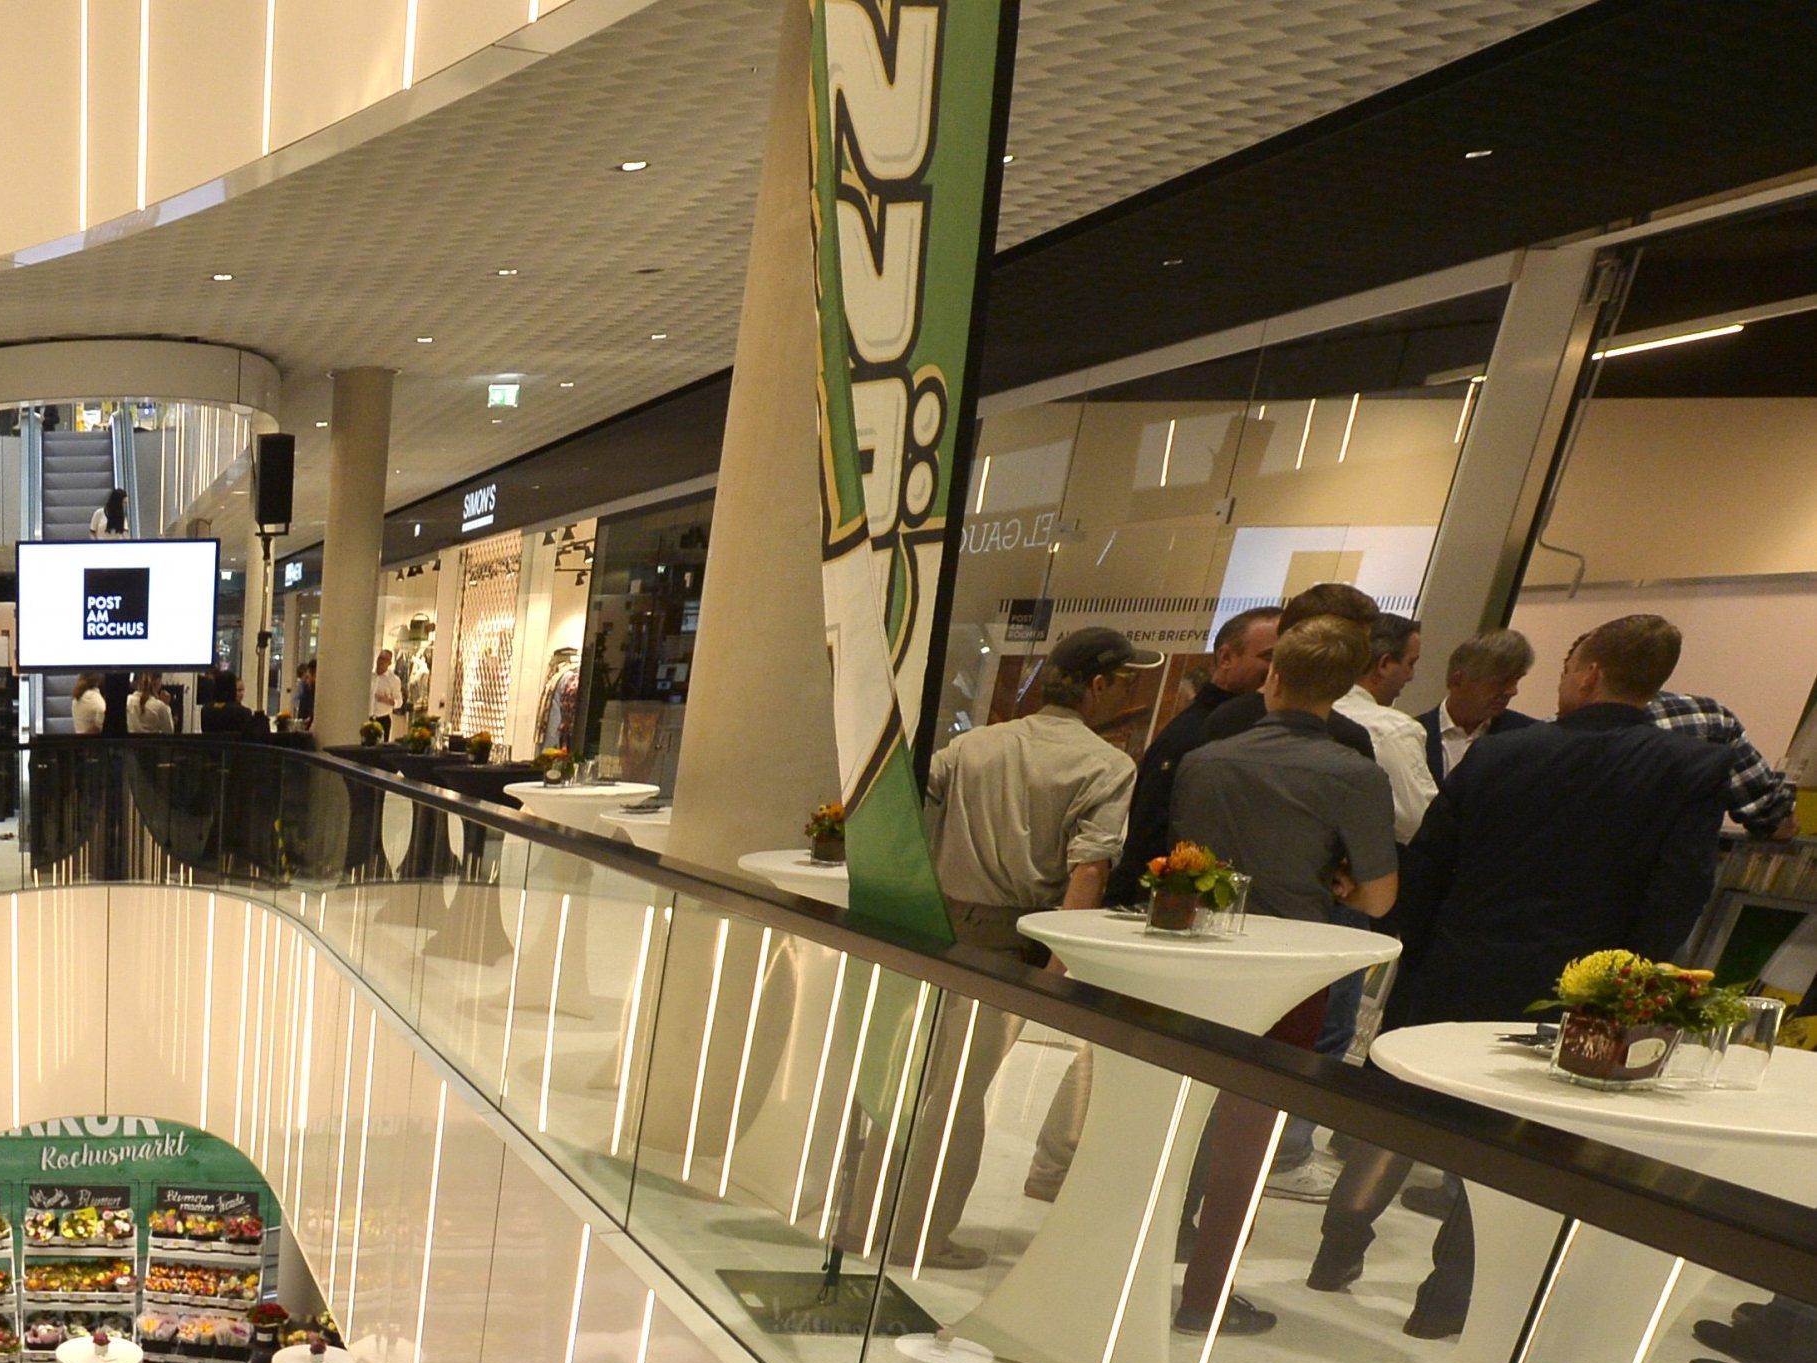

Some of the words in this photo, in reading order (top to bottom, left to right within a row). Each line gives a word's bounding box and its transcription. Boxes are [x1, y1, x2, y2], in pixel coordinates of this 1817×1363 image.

[463, 483, 497, 520] SIMON'S
[87, 596, 122, 610] POST
[86, 609, 109, 623] AM
[87, 622, 145, 636] ROCHUS
[41, 1130, 190, 1171] Rochusmarkt
[164, 1189, 208, 1203] Blumen
